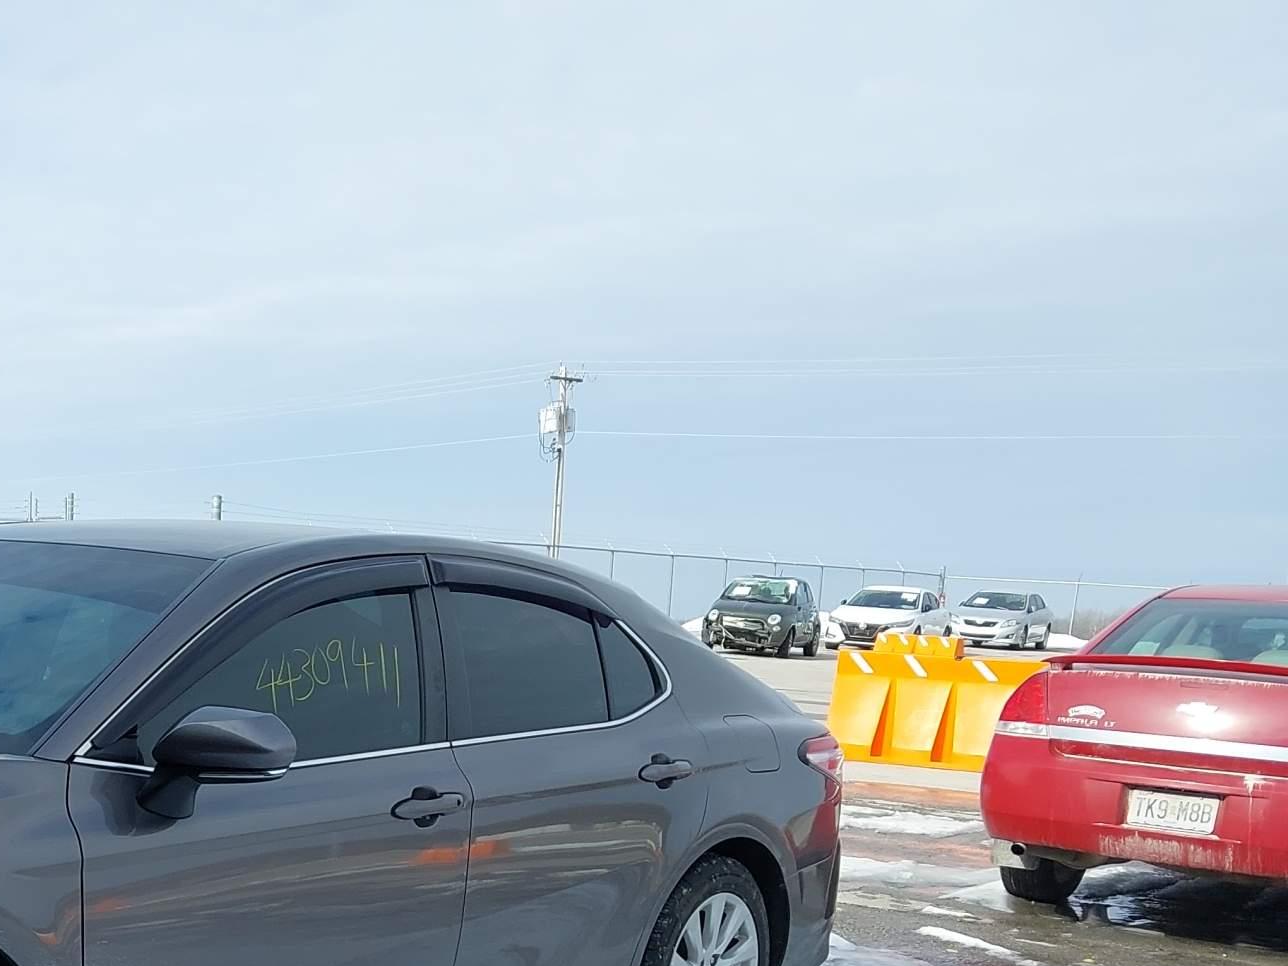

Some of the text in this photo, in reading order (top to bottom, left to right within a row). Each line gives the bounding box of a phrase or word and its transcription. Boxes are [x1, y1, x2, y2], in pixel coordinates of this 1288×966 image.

[256, 633, 400, 714] 44309411
[1057, 715, 1117, 728] IMPALA LT
[1135, 796, 1213, 824] TK9 M8B
